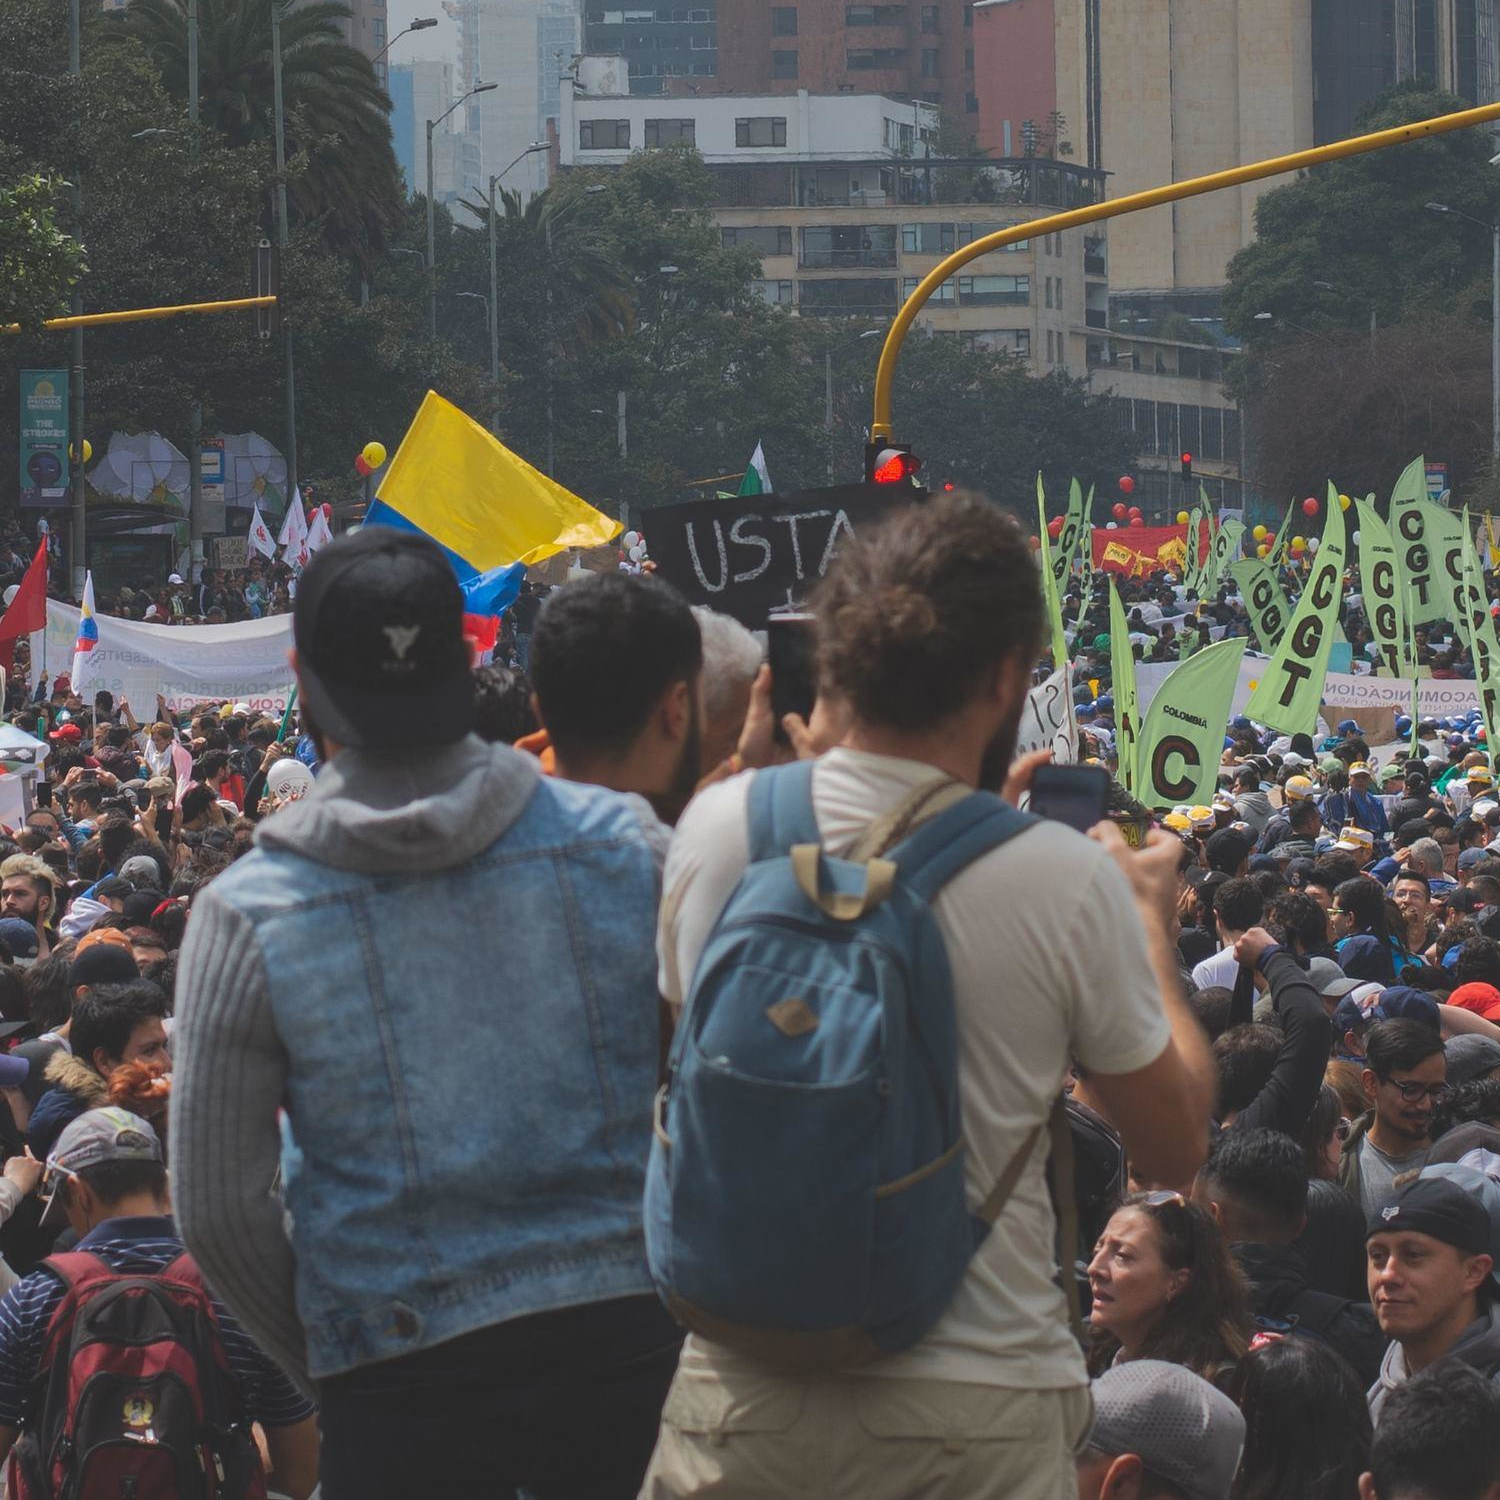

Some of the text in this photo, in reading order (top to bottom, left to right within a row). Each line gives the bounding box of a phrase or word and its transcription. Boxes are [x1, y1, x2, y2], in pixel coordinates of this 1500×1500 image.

[23, 428, 66, 438] STROKES
[36, 419, 53, 428] THE
[685, 509, 858, 593] USTA
[1399, 509, 1431, 606] CGT
[1278, 563, 1337, 707] CGT
[1372, 561, 1400, 679] CGT
[1163, 704, 1208, 730] COLOMBIA
[1151, 734, 1201, 801] C
